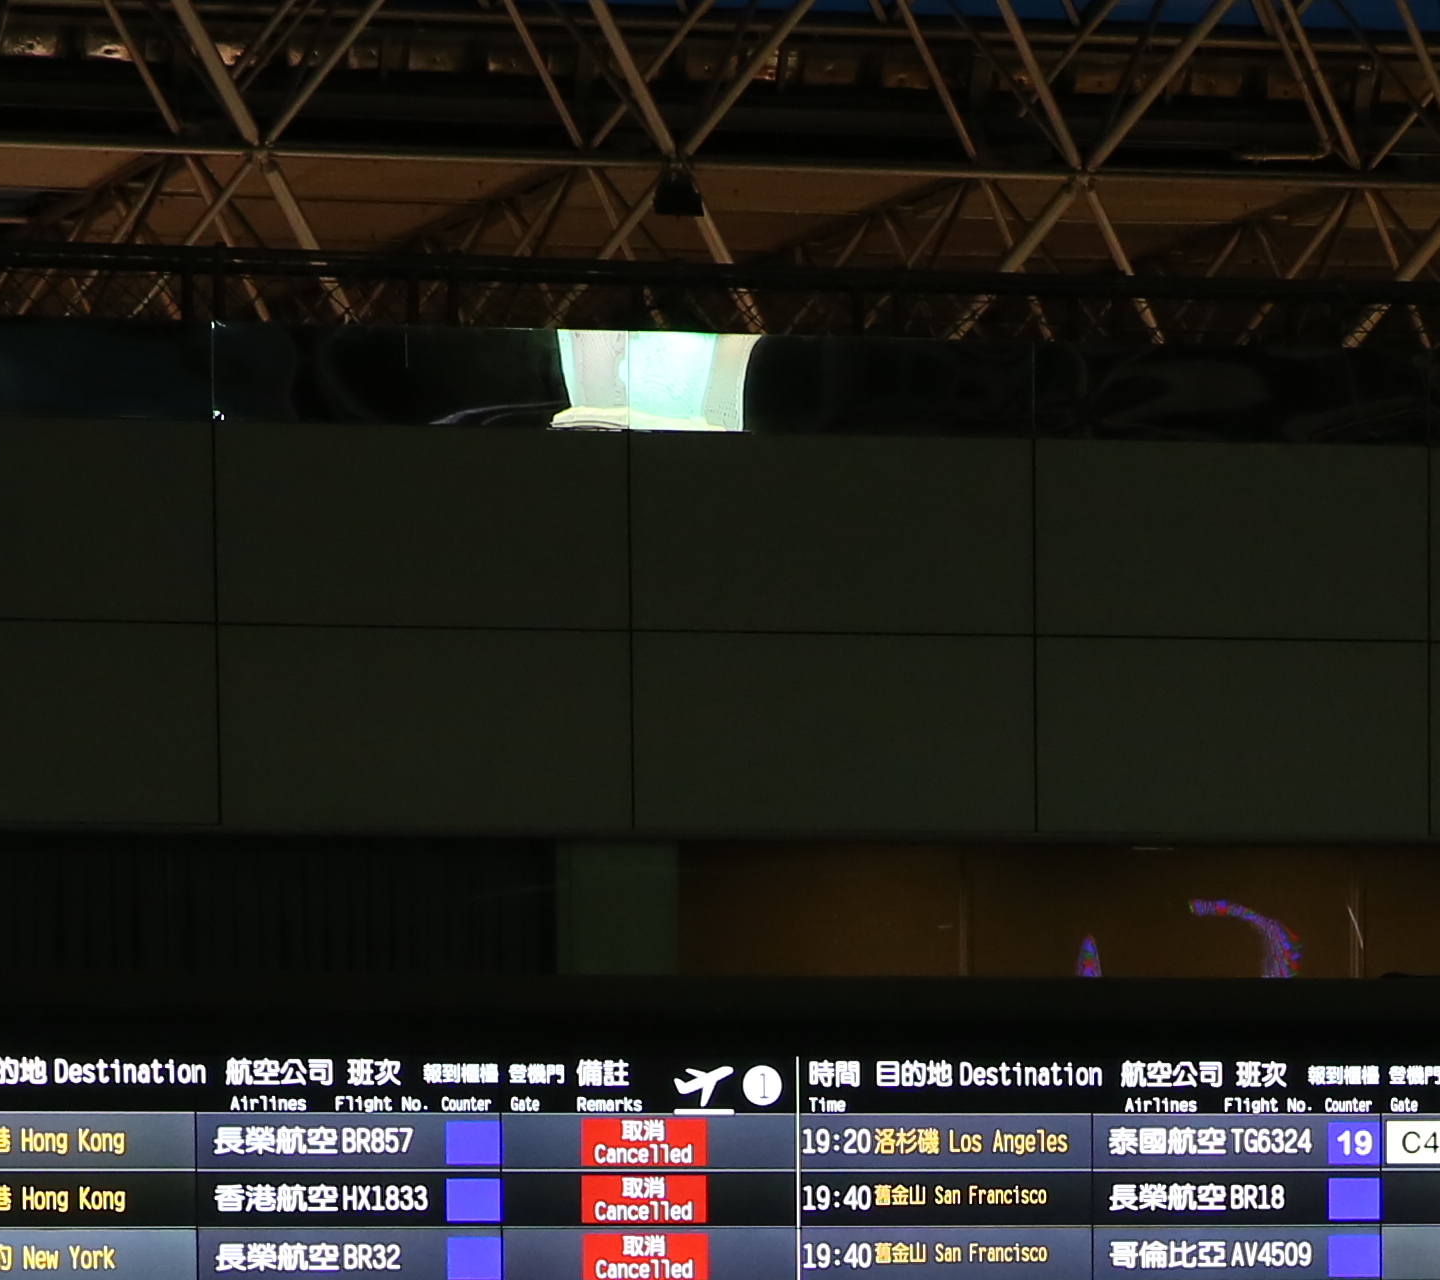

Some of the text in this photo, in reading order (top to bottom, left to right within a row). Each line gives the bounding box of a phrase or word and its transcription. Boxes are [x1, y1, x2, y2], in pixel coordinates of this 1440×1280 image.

[54, 1058, 206, 1084] Destination
[226, 1057, 333, 1085] 航空公司
[347, 1058, 401, 1086] 班次
[509, 1064, 564, 1084] 登機門
[576, 1059, 629, 1086] 備註
[230, 1096, 306, 1111] Airlines
[334, 1095, 394, 1113] Flight
[402, 1096, 428, 1111] No.
[442, 1096, 491, 1111] Counter
[511, 1096, 540, 1111] Gate
[577, 1097, 642, 1112] Remarks
[22, 1128, 67, 1154] Hong
[79, 1128, 124, 1154] Kong
[214, 1126, 338, 1154] 長榮航空
[342, 1128, 413, 1153] BR857
[622, 1119, 664, 1141] 取消
[595, 1144, 692, 1163] Cancelled
[803, 1183, 1284, 1211] 19:40 舊金山 San Francisco 長榮航空 BR18
